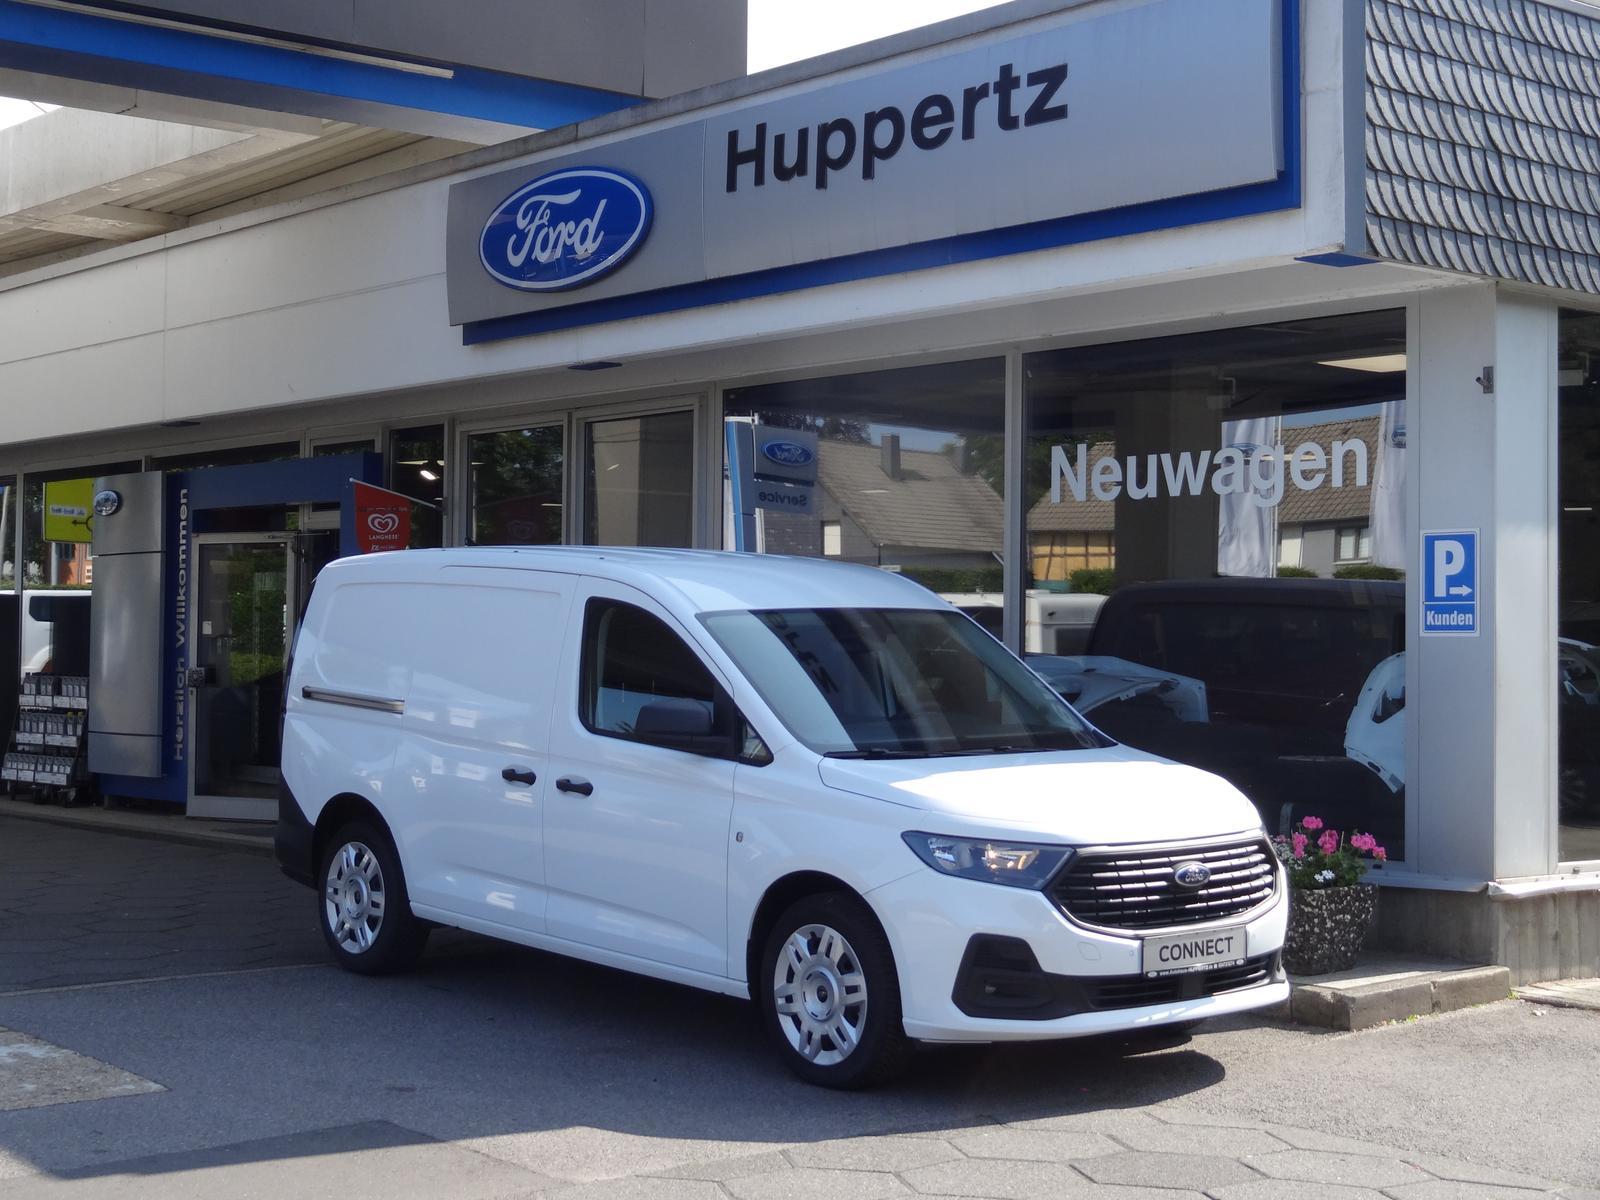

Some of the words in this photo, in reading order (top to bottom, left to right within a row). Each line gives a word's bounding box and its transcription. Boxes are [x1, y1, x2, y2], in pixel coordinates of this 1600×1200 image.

[726, 63, 1068, 193] Huppertz
[506, 188, 605, 270] Ford
[1051, 437, 1368, 507] Neuwagen
[174, 487, 189, 648] Willkommen
[1433, 539, 1466, 598] P
[1425, 608, 1474, 627] Kunden
[174, 656, 187, 762] Herzlich
[1159, 937, 1233, 962] CONNECT
